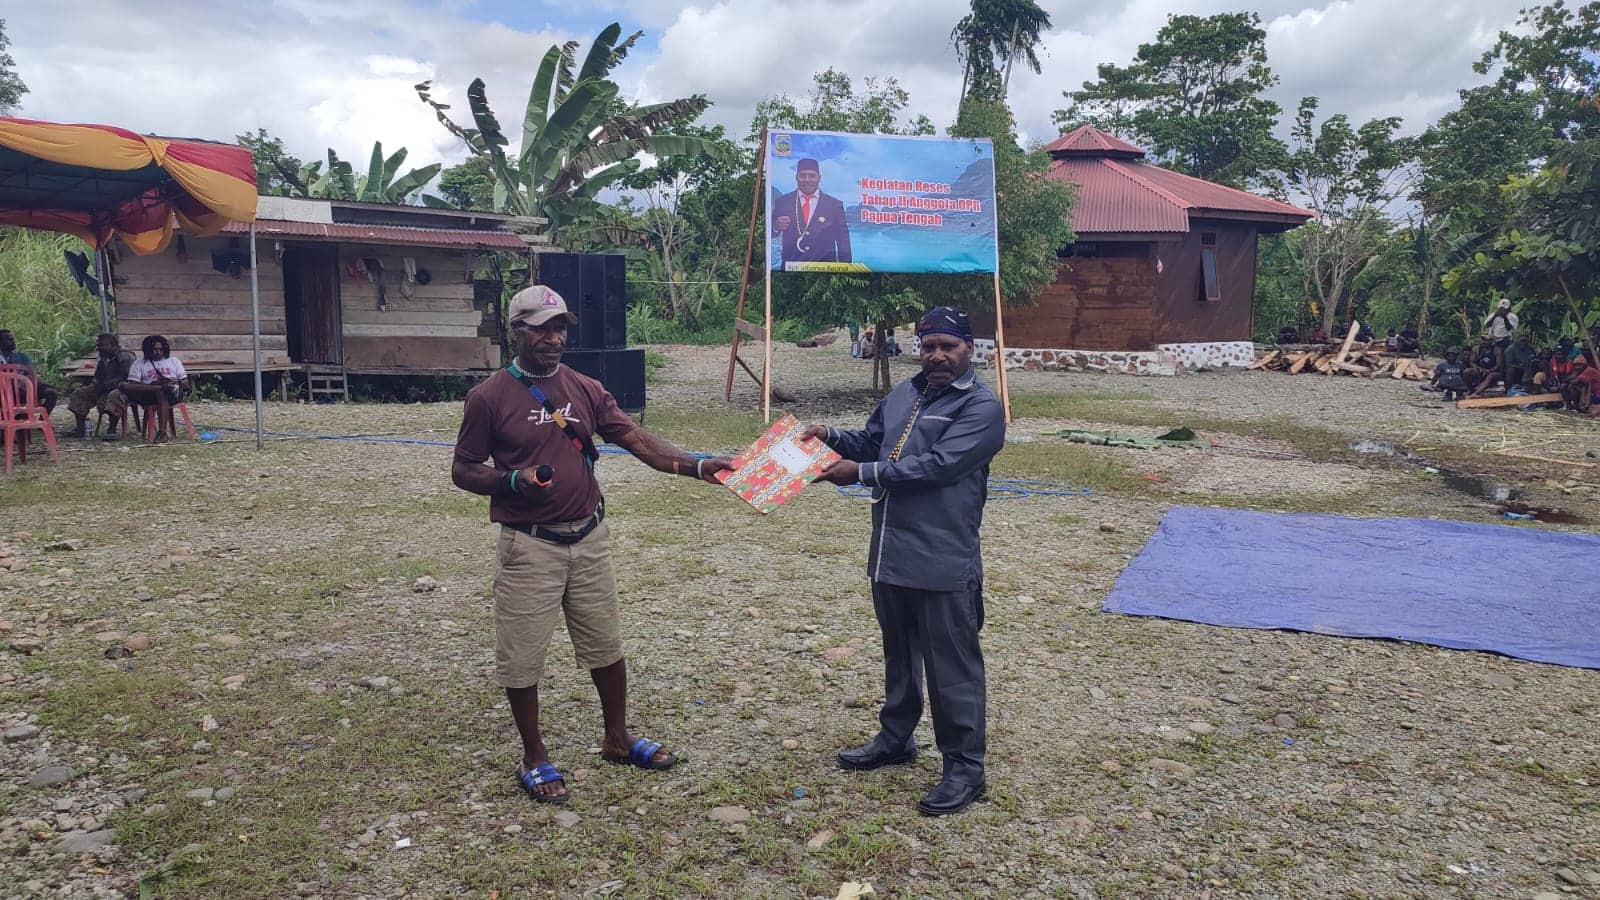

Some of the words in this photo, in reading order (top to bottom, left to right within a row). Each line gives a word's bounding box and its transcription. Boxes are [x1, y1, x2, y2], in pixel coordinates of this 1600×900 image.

[860, 176, 913, 192] Kegiatan
[914, 179, 951, 195] Reses
[860, 192, 896, 208] Tahap
[909, 196, 957, 211] Anggota
[957, 198, 981, 212] DPR
[861, 208, 898, 224] Papua
[899, 210, 943, 226] Tengah
